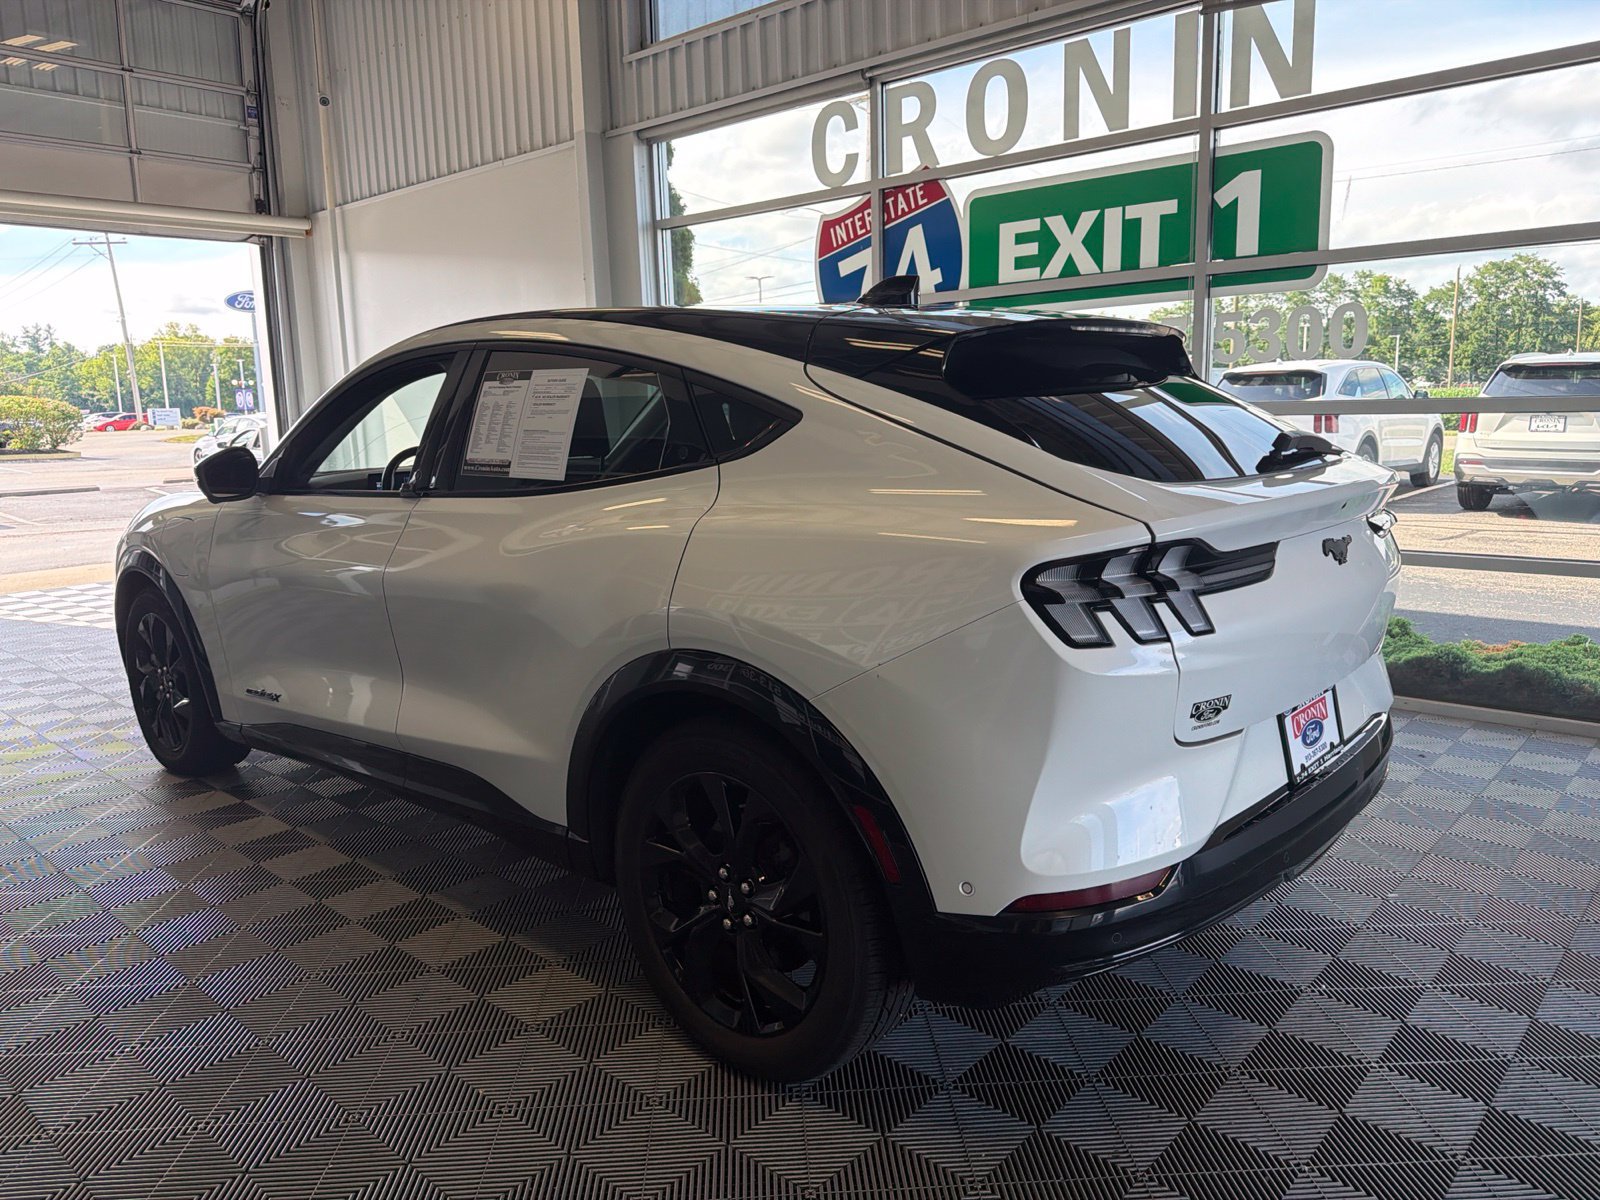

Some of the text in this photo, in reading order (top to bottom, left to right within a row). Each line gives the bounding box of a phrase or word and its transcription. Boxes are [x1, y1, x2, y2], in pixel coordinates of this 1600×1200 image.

[812, 0, 1315, 188] CRONIN
[998, 169, 1263, 284] EXIT 1
[838, 223, 943, 302] 74
[1192, 696, 1230, 714] CRONIN
[1293, 699, 1327, 736] CRONIN
[1305, 723, 1320, 744] Ford
[1308, 761, 1320, 774] EXIT
